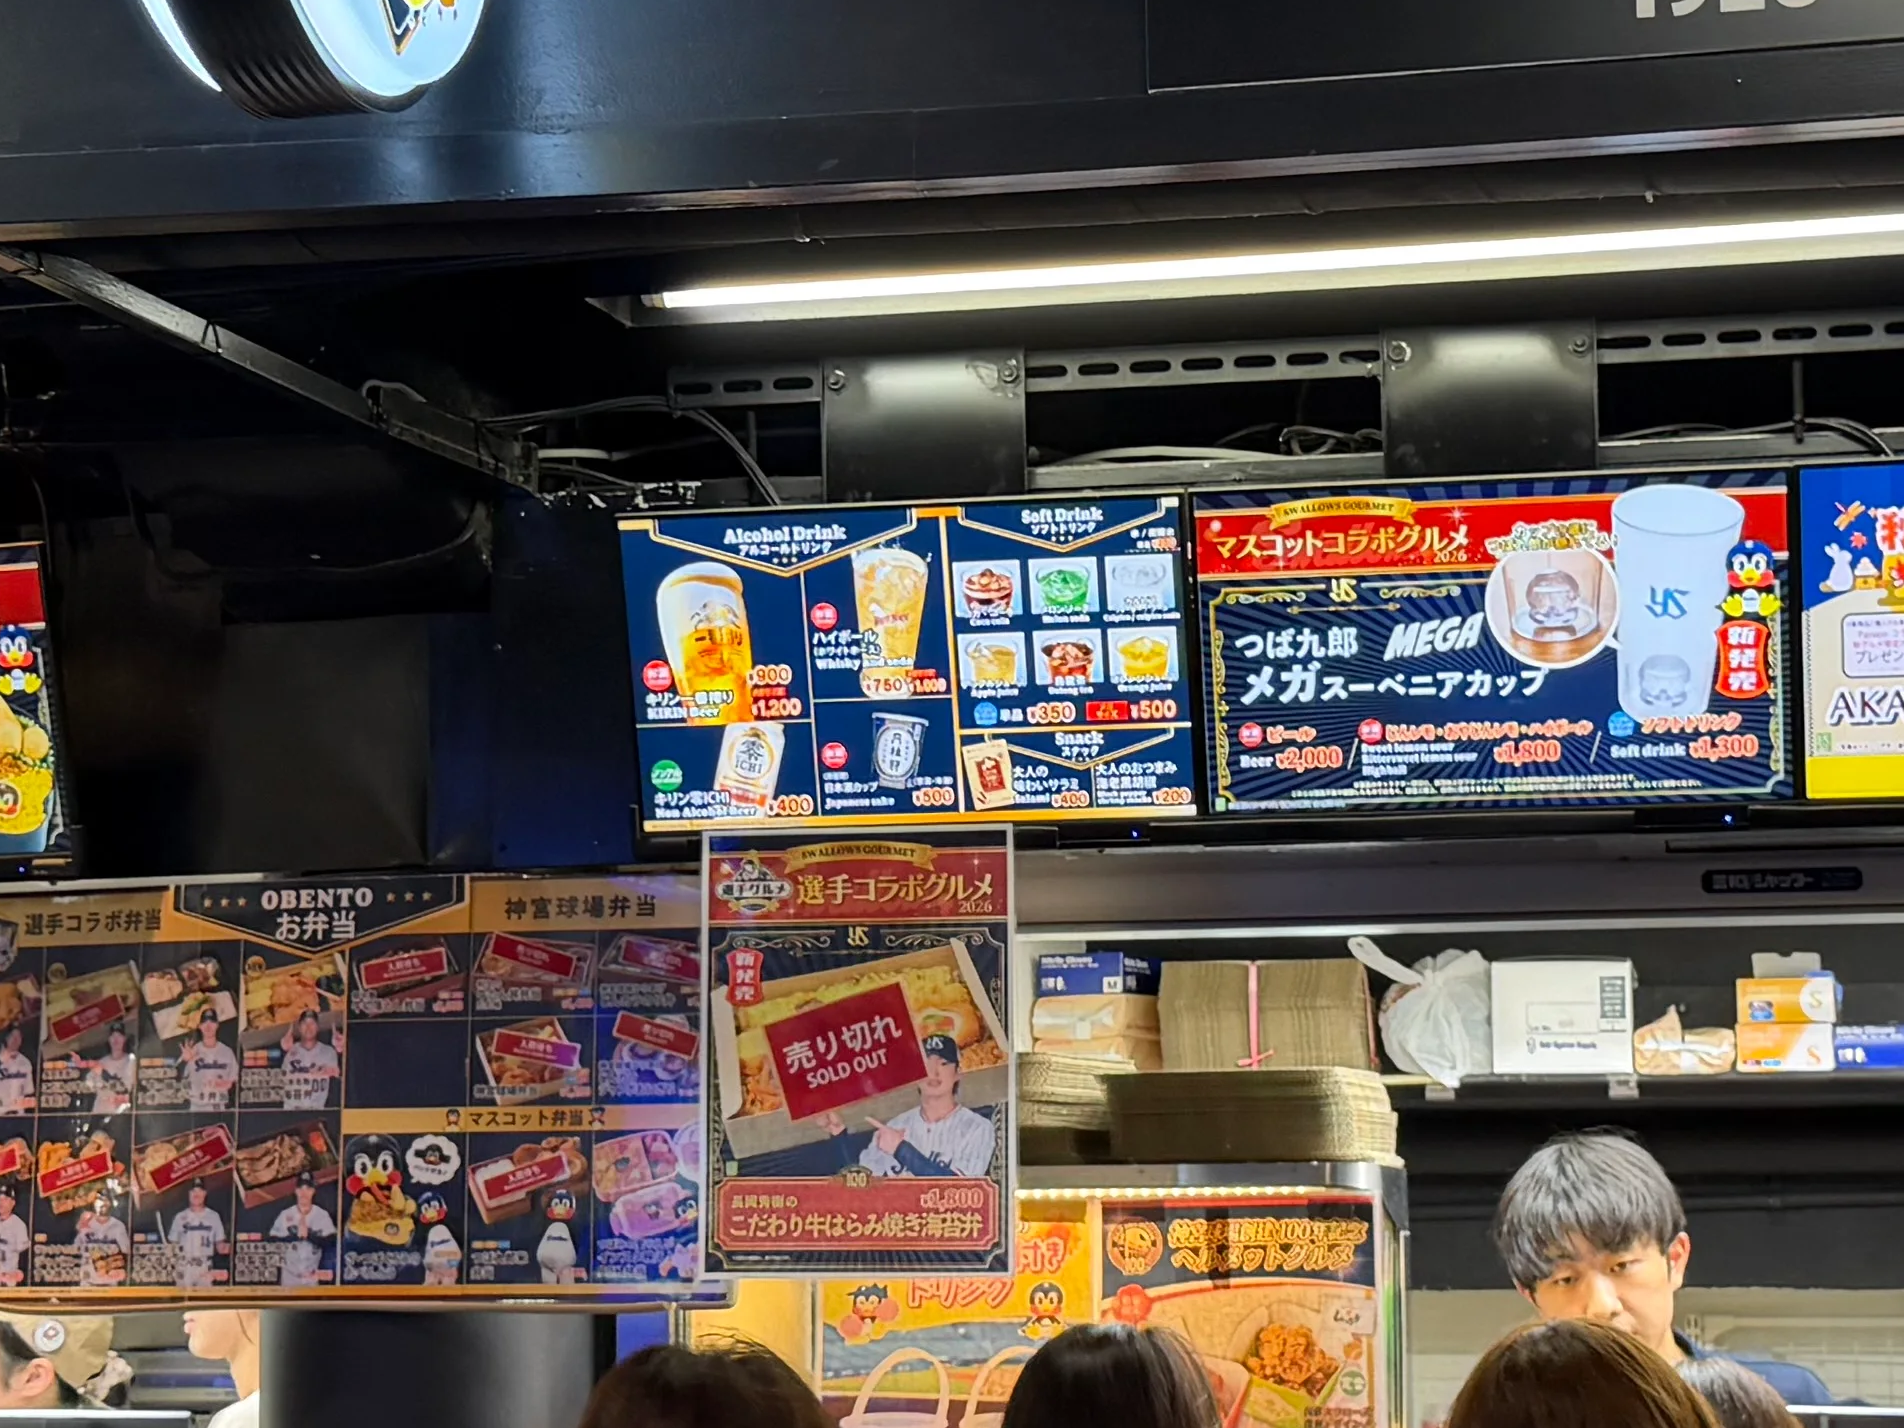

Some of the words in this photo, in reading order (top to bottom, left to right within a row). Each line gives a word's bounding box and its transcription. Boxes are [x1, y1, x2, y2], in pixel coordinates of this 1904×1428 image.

[1022, 509, 1052, 524] Soft
[1055, 507, 1103, 522] Drink
[1282, 499, 1340, 517] SWALLOWS
[1343, 499, 1394, 513] GOURMET
[724, 528, 790, 544] Alcohol
[793, 525, 846, 541] Drink
[1213, 522, 1470, 560] マスコットコラボグルメ
[739, 542, 832, 555] アルコールドリンク
[1432, 548, 1468, 564] 2026
[813, 631, 877, 645] ハイボール
[1233, 627, 1358, 659] つば九郎
[1384, 614, 1486, 661] MEGA
[1728, 627, 1756, 691] 新発売
[747, 665, 792, 685] ¥900
[864, 677, 903, 692] ¥750
[1239, 663, 1547, 706] メガスーベニアカップ
[647, 707, 688, 719] KIRIN
[690, 707, 719, 717] Beer
[752, 698, 802, 716] ¥1,200
[1027, 702, 1076, 724] ¥350
[1130, 700, 1176, 719] ¥500
[1055, 732, 1104, 745] Snack
[1690, 734, 1759, 762] ¥1,300
[1276, 747, 1342, 772] ¥2,000
[1494, 741, 1561, 766] ¥1,800
[1611, 744, 1640, 758] Soft
[1642, 742, 1686, 756] drink
[1096, 762, 1177, 774] 大人のおつまみ
[1240, 755, 1273, 767] Beer
[1013, 765, 1048, 777] 大人の
[767, 795, 814, 816] ¥400
[912, 789, 955, 805] ¥500
[1052, 791, 1090, 806] ¥400
[1152, 788, 1191, 805] ¥200
[800, 847, 862, 859] SWALLOWS
[864, 845, 916, 859] GOURMET
[261, 887, 374, 909] OBENTO
[722, 881, 789, 898] 選手グルメ
[797, 873, 993, 904] 選手コラボグルメ
[505, 894, 656, 920] 神宮球場弁当
[958, 901, 993, 914] 2026
[25, 908, 161, 936] 選手コラボ弁当
[276, 912, 356, 941] お弁当
[784, 1015, 902, 1071] 売り切れ
[807, 1062, 850, 1090] SOLD
[854, 1048, 888, 1076] OUT
[469, 1110, 583, 1126] マスコット弁当
[731, 1213, 983, 1238] こだわり牛はらみ焼き海苔弁
